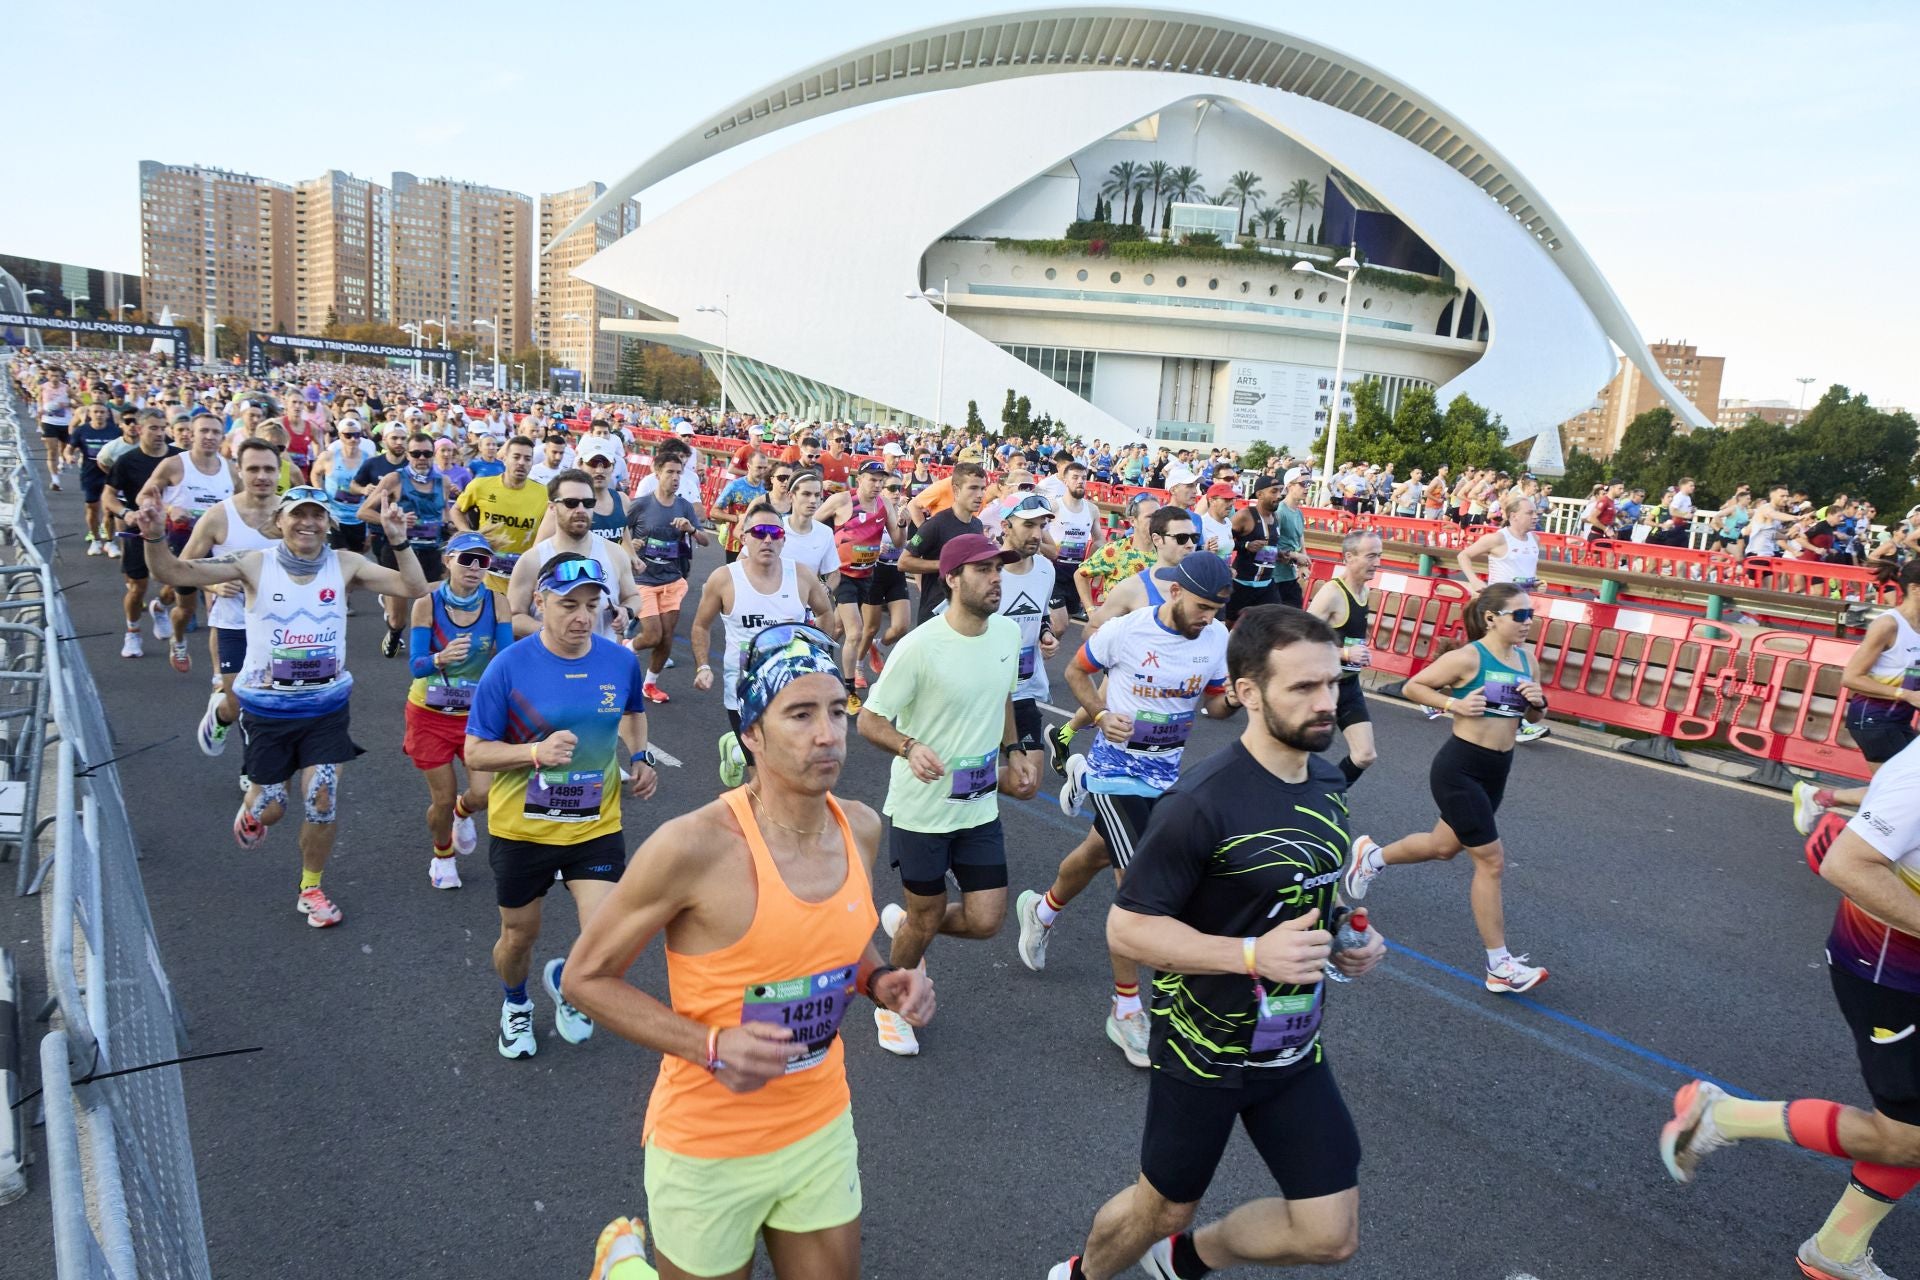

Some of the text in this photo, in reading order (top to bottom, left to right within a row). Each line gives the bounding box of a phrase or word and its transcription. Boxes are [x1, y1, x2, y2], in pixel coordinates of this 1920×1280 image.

[26, 317, 80, 330] TRINIDAD
[80, 322, 133, 334] ALFONSO
[146, 328, 172, 336] ZURICH
[287, 336, 324, 349] VALENCIA
[324, 341, 369, 353] TRINIDAD
[368, 345, 413, 357] ALFONSO
[423, 352, 445, 360] ZURICH
[1238, 367, 1252, 377] LES
[1237, 377, 1257, 385] ARTS
[1023, 616, 1039, 624] TRAIL
[270, 627, 337, 646] Slovenia
[549, 786, 584, 797] 14895
[549, 798, 581, 808] EFREN
[782, 996, 834, 1025] 14219
[791, 1020, 832, 1042] ARLOS
